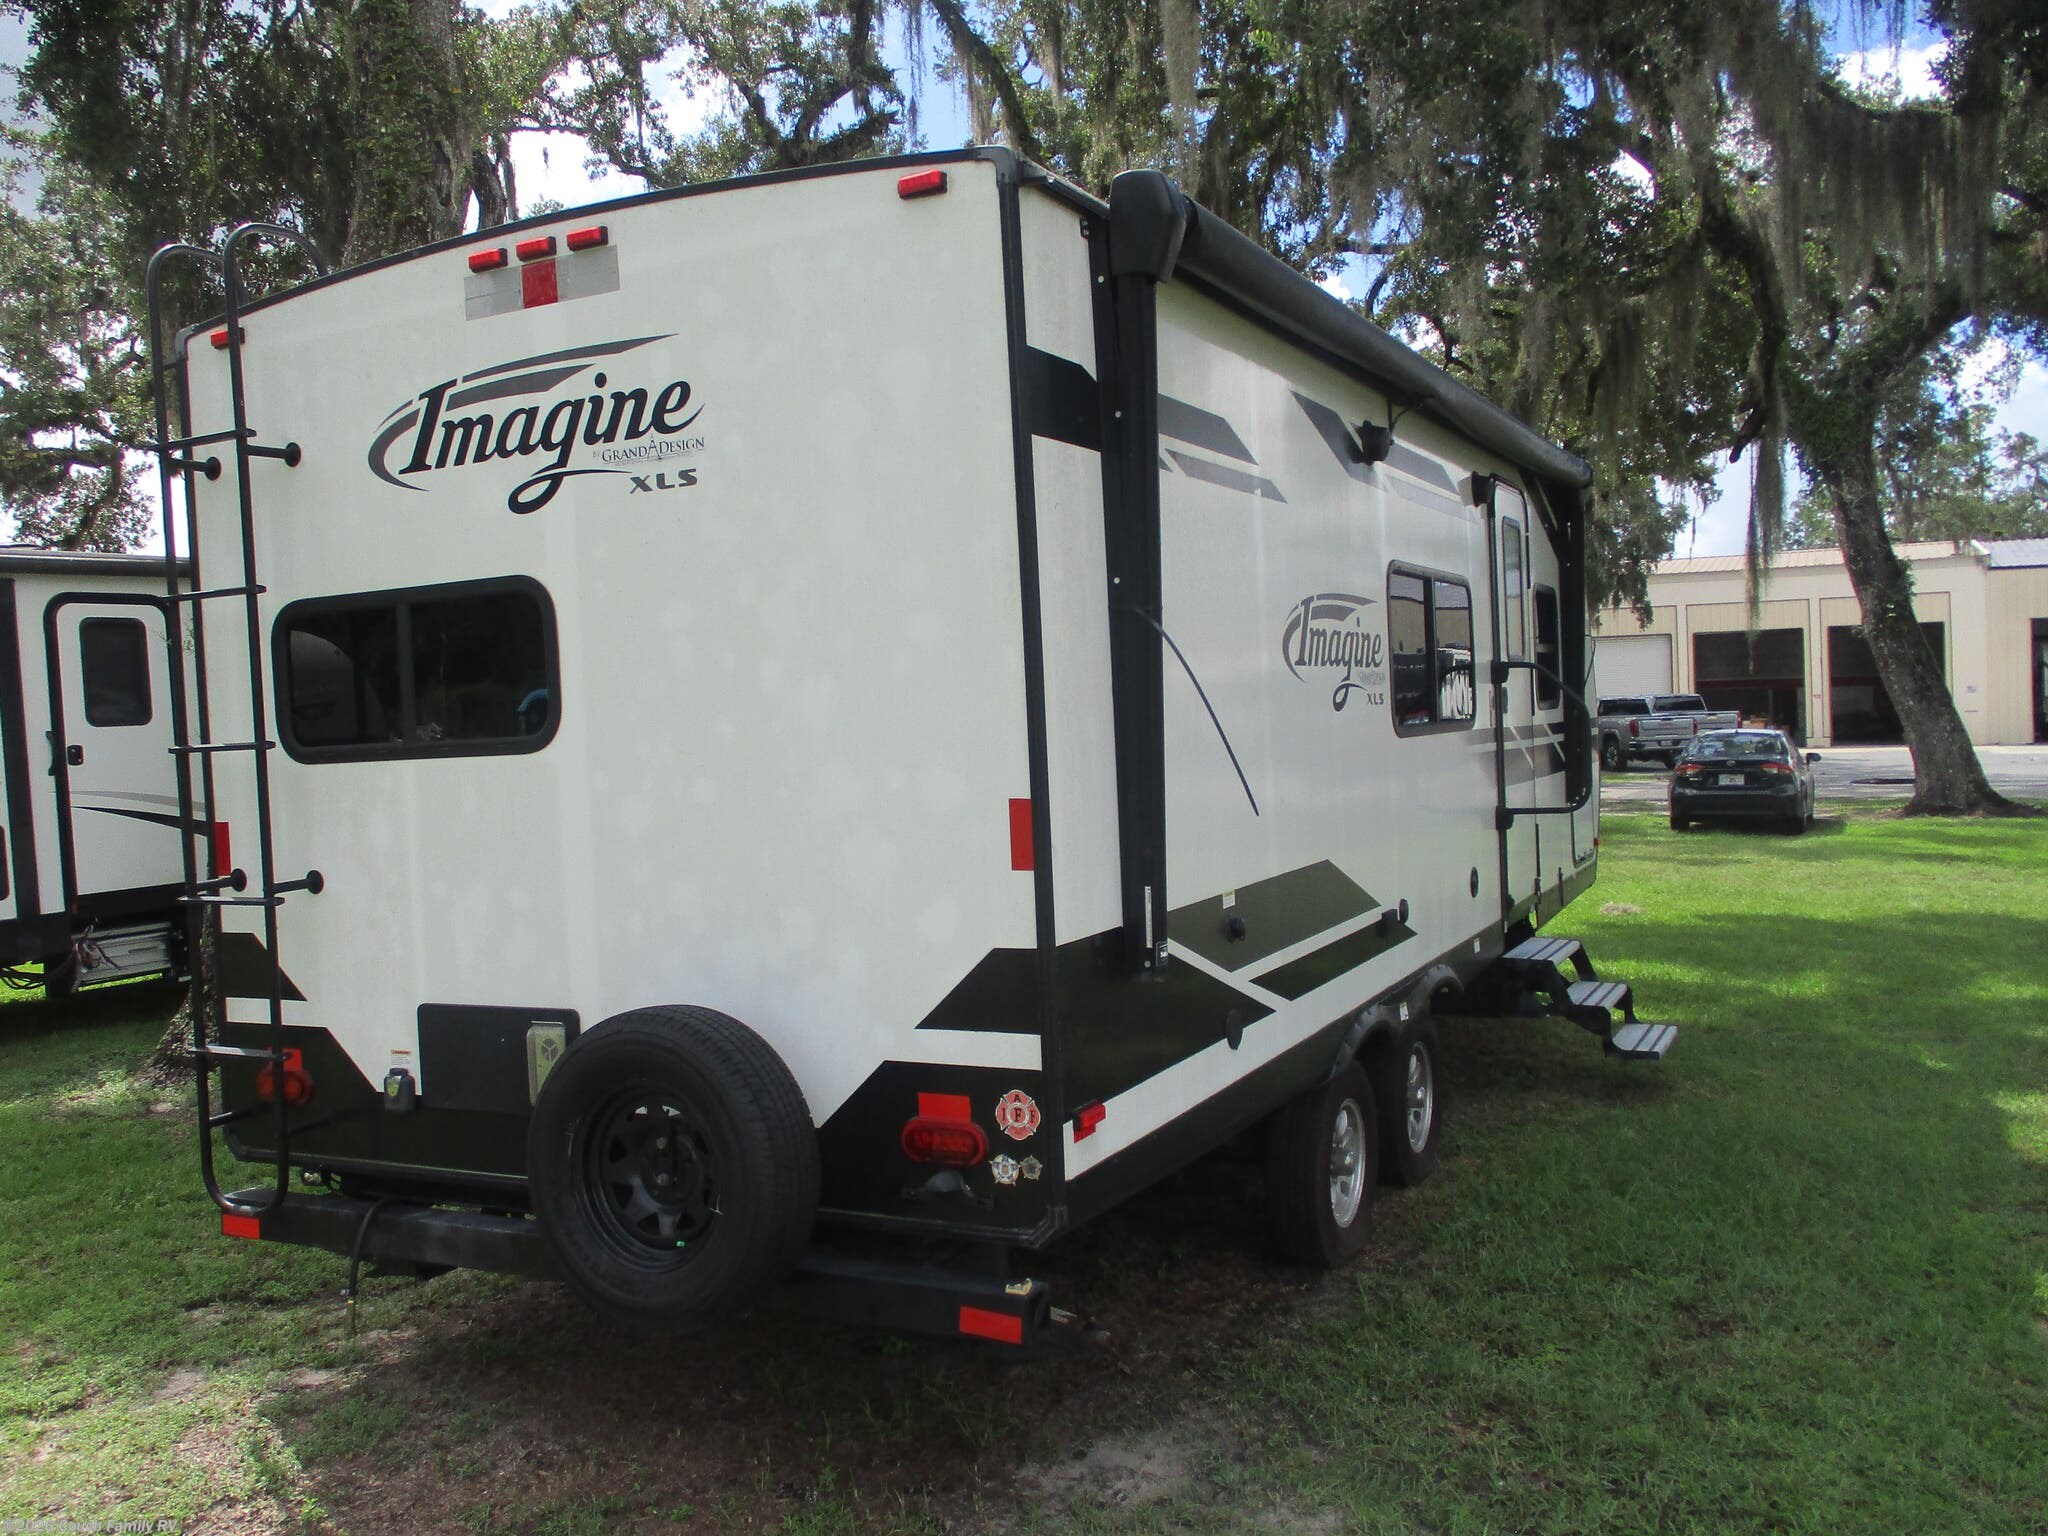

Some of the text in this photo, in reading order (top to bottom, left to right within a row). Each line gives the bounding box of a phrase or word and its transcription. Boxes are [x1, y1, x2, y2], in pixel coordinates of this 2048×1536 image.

[397, 371, 705, 515] Imagine
[629, 468, 698, 494] XLS
[1294, 594, 1384, 712] Imagine
[1366, 692, 1384, 705] XLS
